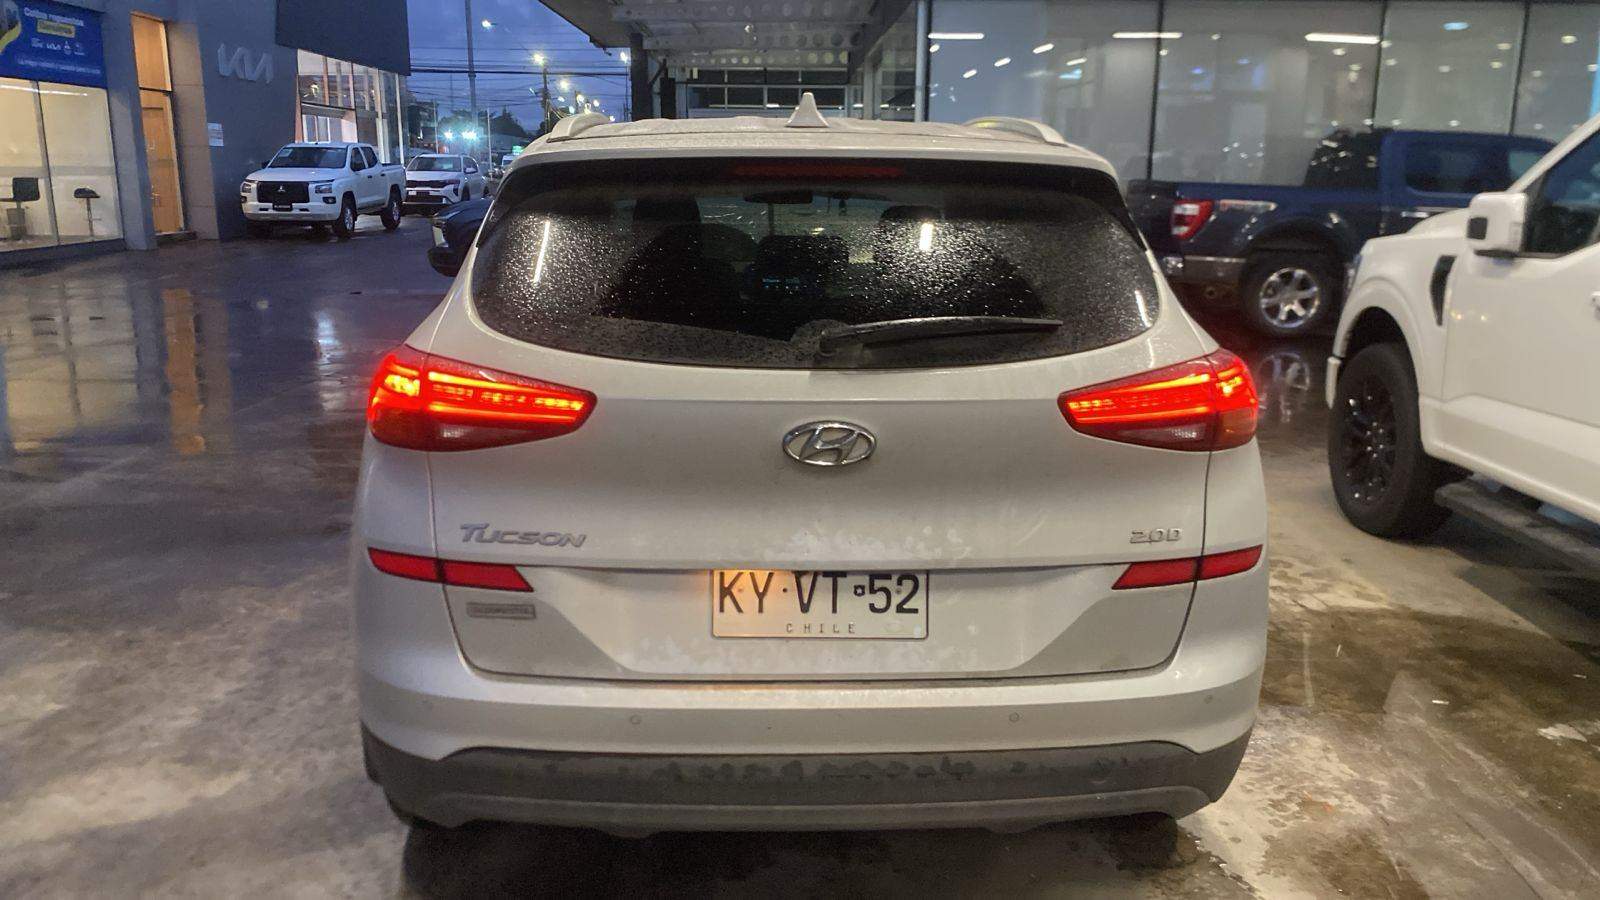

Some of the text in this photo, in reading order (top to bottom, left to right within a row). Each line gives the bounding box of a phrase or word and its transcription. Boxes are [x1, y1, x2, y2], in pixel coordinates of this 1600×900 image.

[217, 43, 274, 84] KIA
[460, 522, 587, 548] TUCSON
[785, 622, 857, 635] CHILE
